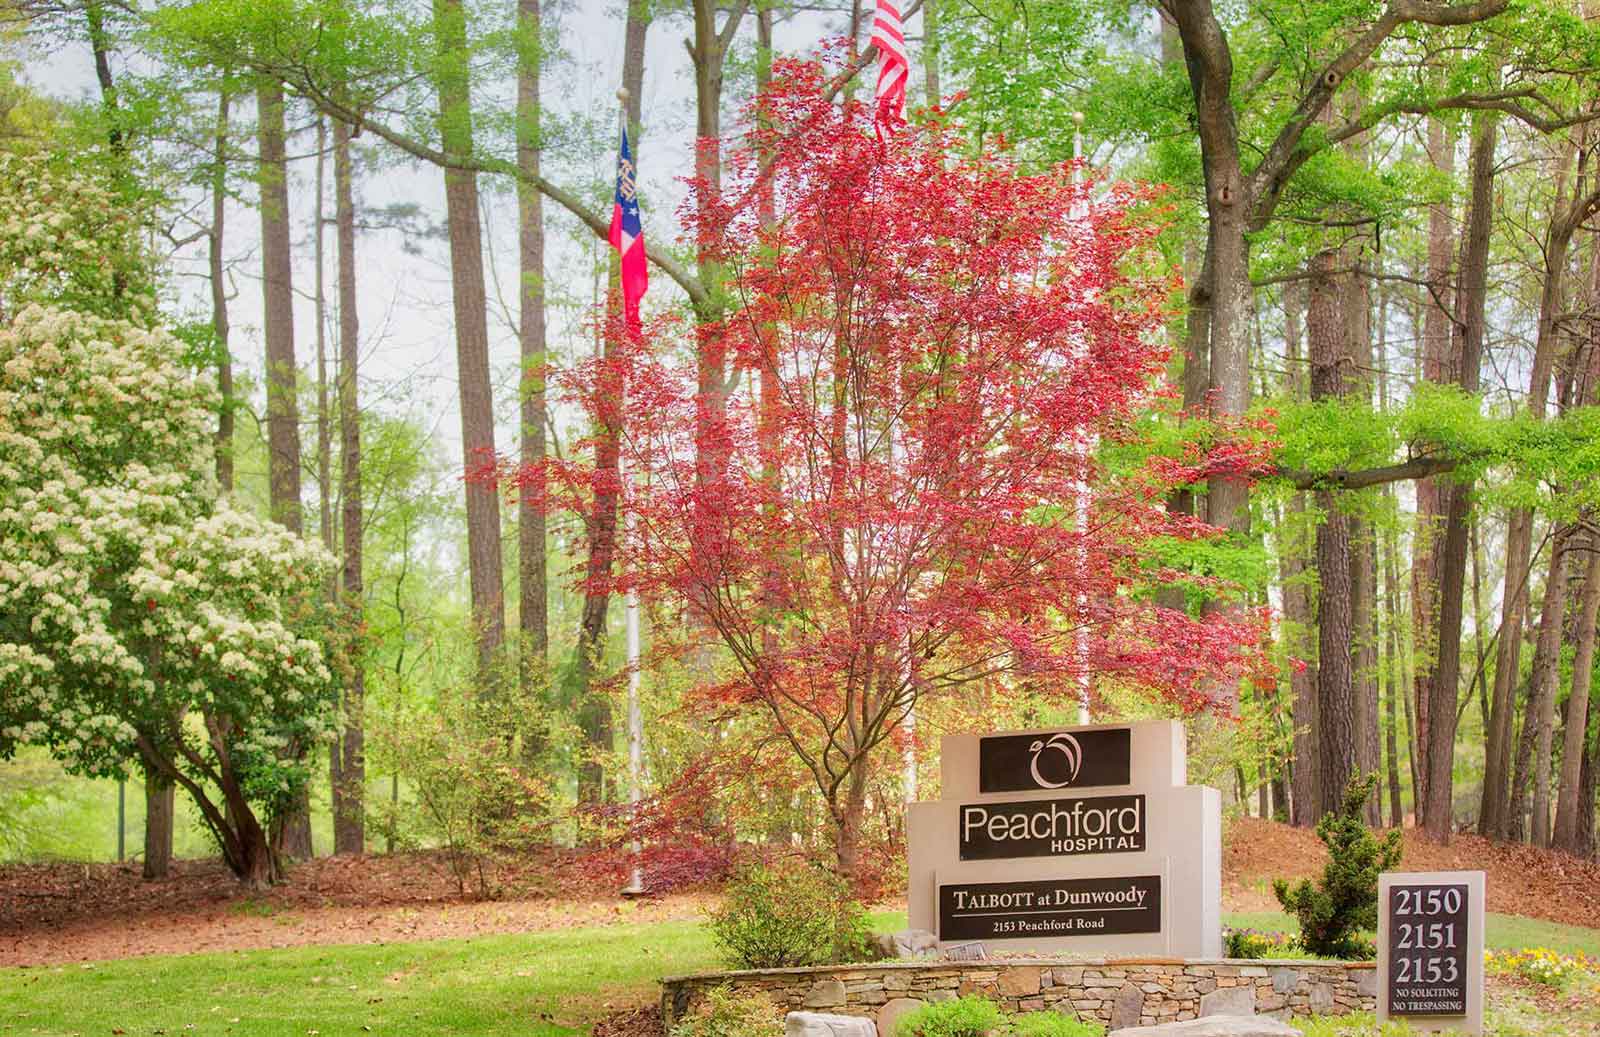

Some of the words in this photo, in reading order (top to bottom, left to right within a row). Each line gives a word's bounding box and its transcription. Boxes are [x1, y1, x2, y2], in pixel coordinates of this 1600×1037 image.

[964, 799, 1140, 842] Peachford
[1051, 836, 1140, 853] HOSPITAL
[953, 890, 1035, 909] TALBOTT
[1037, 894, 1051, 906] at
[1054, 885, 1147, 906] Dunwoody
[1395, 888, 1461, 916] 2150
[993, 921, 1016, 932] 2153
[1018, 918, 1073, 931] Peachford
[1076, 917, 1105, 929] Road
[1398, 922, 1457, 949] 2151
[1396, 956, 1458, 983] 2153
[1396, 988, 1410, 998] NO
[1411, 988, 1459, 998] SOLICITING
[1392, 1001, 1406, 1011] NO
[1407, 1000, 1462, 1011] TRESPASSING
